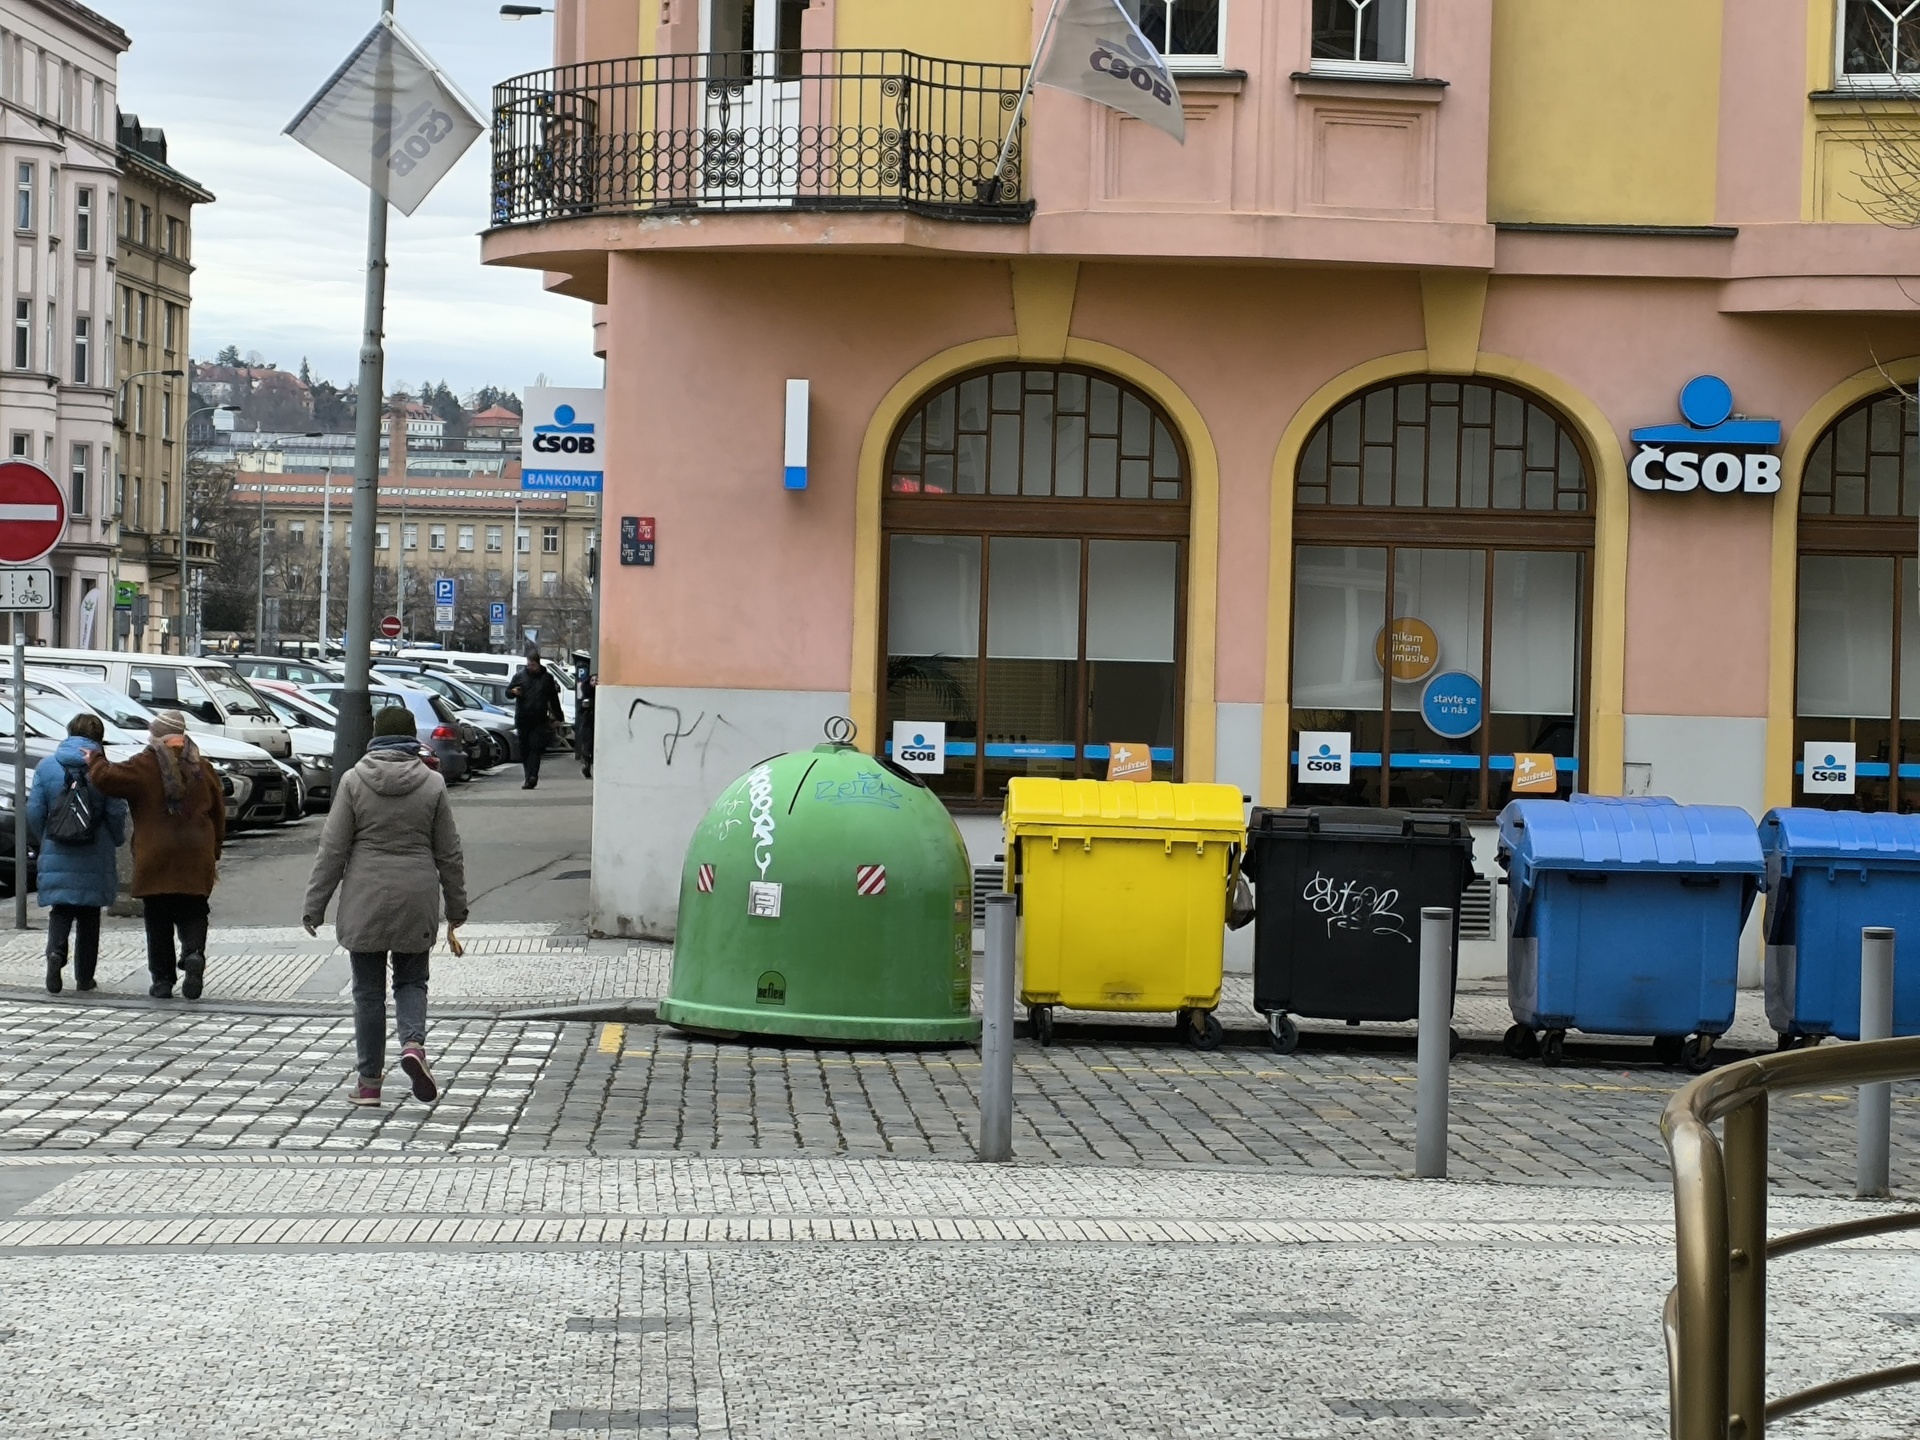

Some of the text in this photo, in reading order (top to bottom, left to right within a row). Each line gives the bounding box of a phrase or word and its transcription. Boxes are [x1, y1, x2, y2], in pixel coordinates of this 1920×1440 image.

[1089, 47, 1172, 106] ČSOB
[532, 433, 595, 453] ČSOB
[1630, 443, 1782, 493] ČSOB
[527, 473, 597, 487] BANKOMAT
[439, 581, 451, 597] P
[1392, 632, 1423, 643] nikam
[1392, 642, 1421, 653] jinam
[1433, 694, 1477, 705] stavte se
[1450, 704, 1468, 714] nás
[901, 750, 936, 762] ČSOB
[1307, 761, 1342, 771] ČSOB
[1812, 771, 1847, 782] ČSOB
